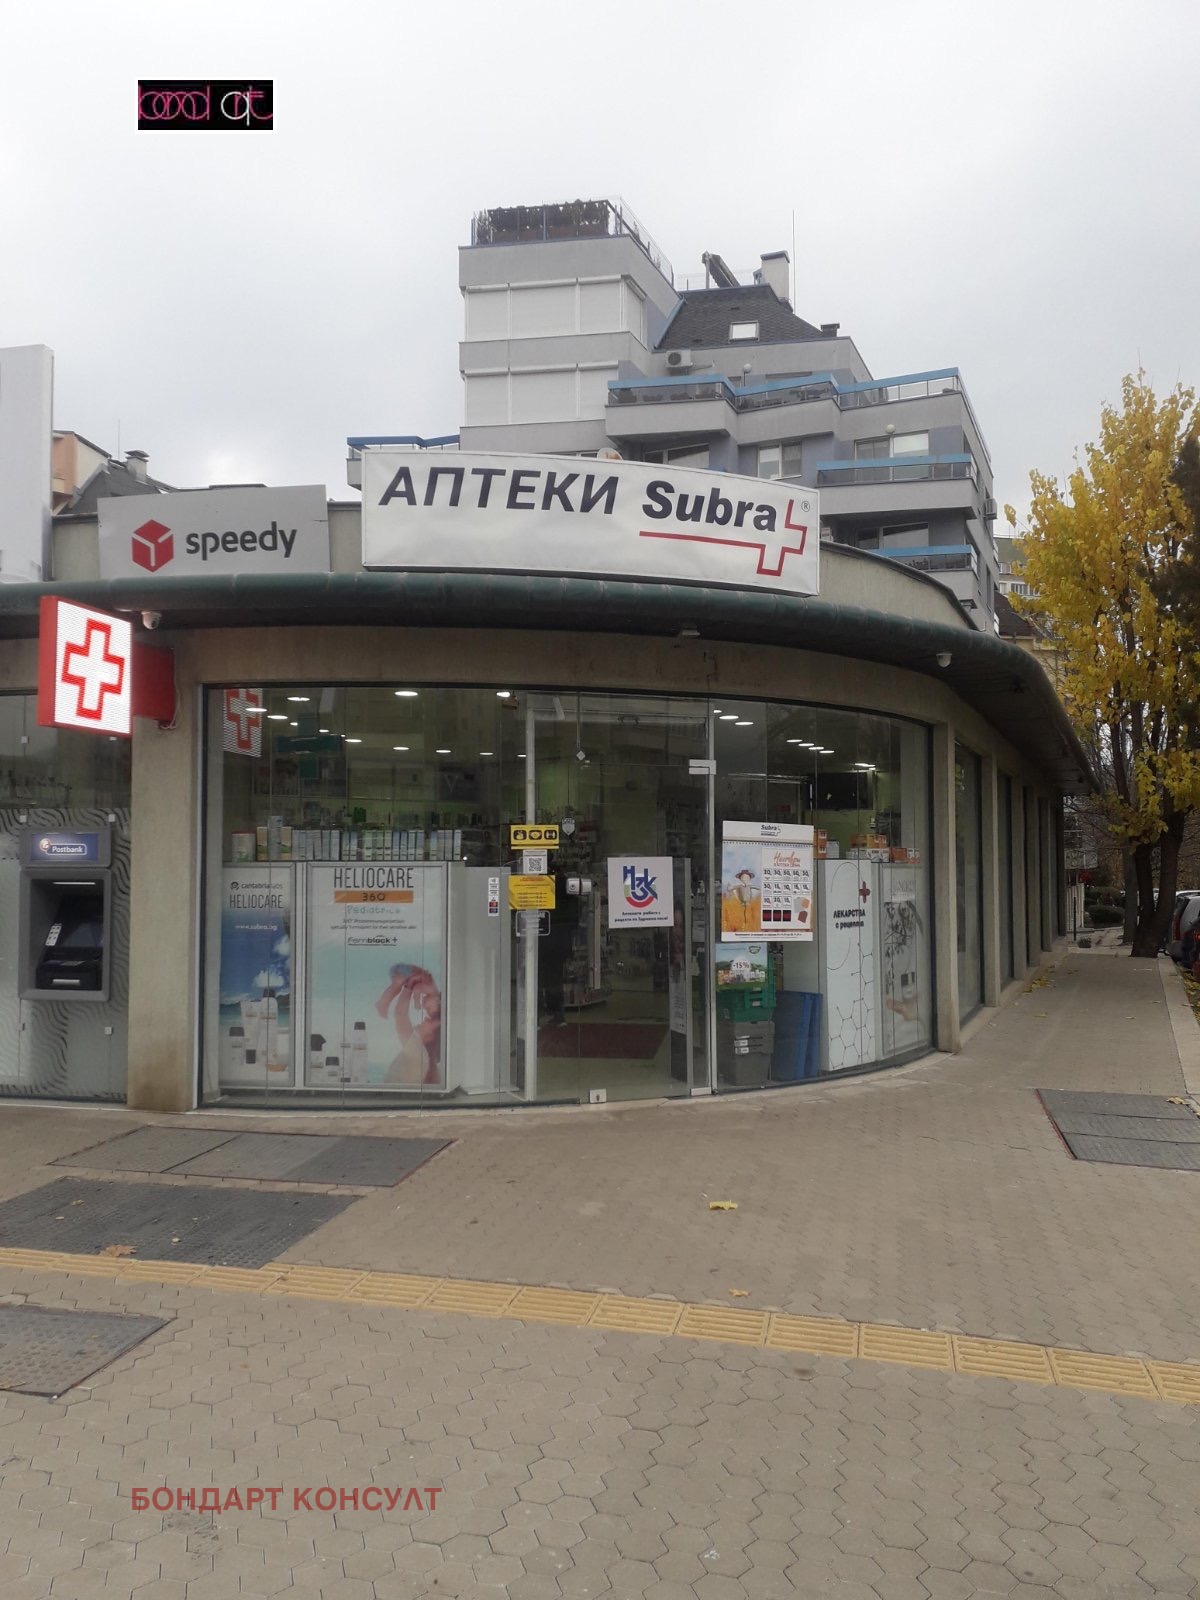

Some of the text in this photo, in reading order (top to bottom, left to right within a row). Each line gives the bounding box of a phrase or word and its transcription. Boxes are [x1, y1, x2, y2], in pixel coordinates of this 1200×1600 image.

[378, 466, 620, 515] АПТЕКИ
[642, 480, 777, 532] Subra
[185, 521, 297, 561] speedy
[52, 845, 83, 853] Postbank
[334, 867, 414, 889] HELIOCARE
[229, 894, 284, 909] HELIOCARE
[362, 892, 386, 902] 360
[833, 908, 866, 919] ЛЕКАРСТВА
